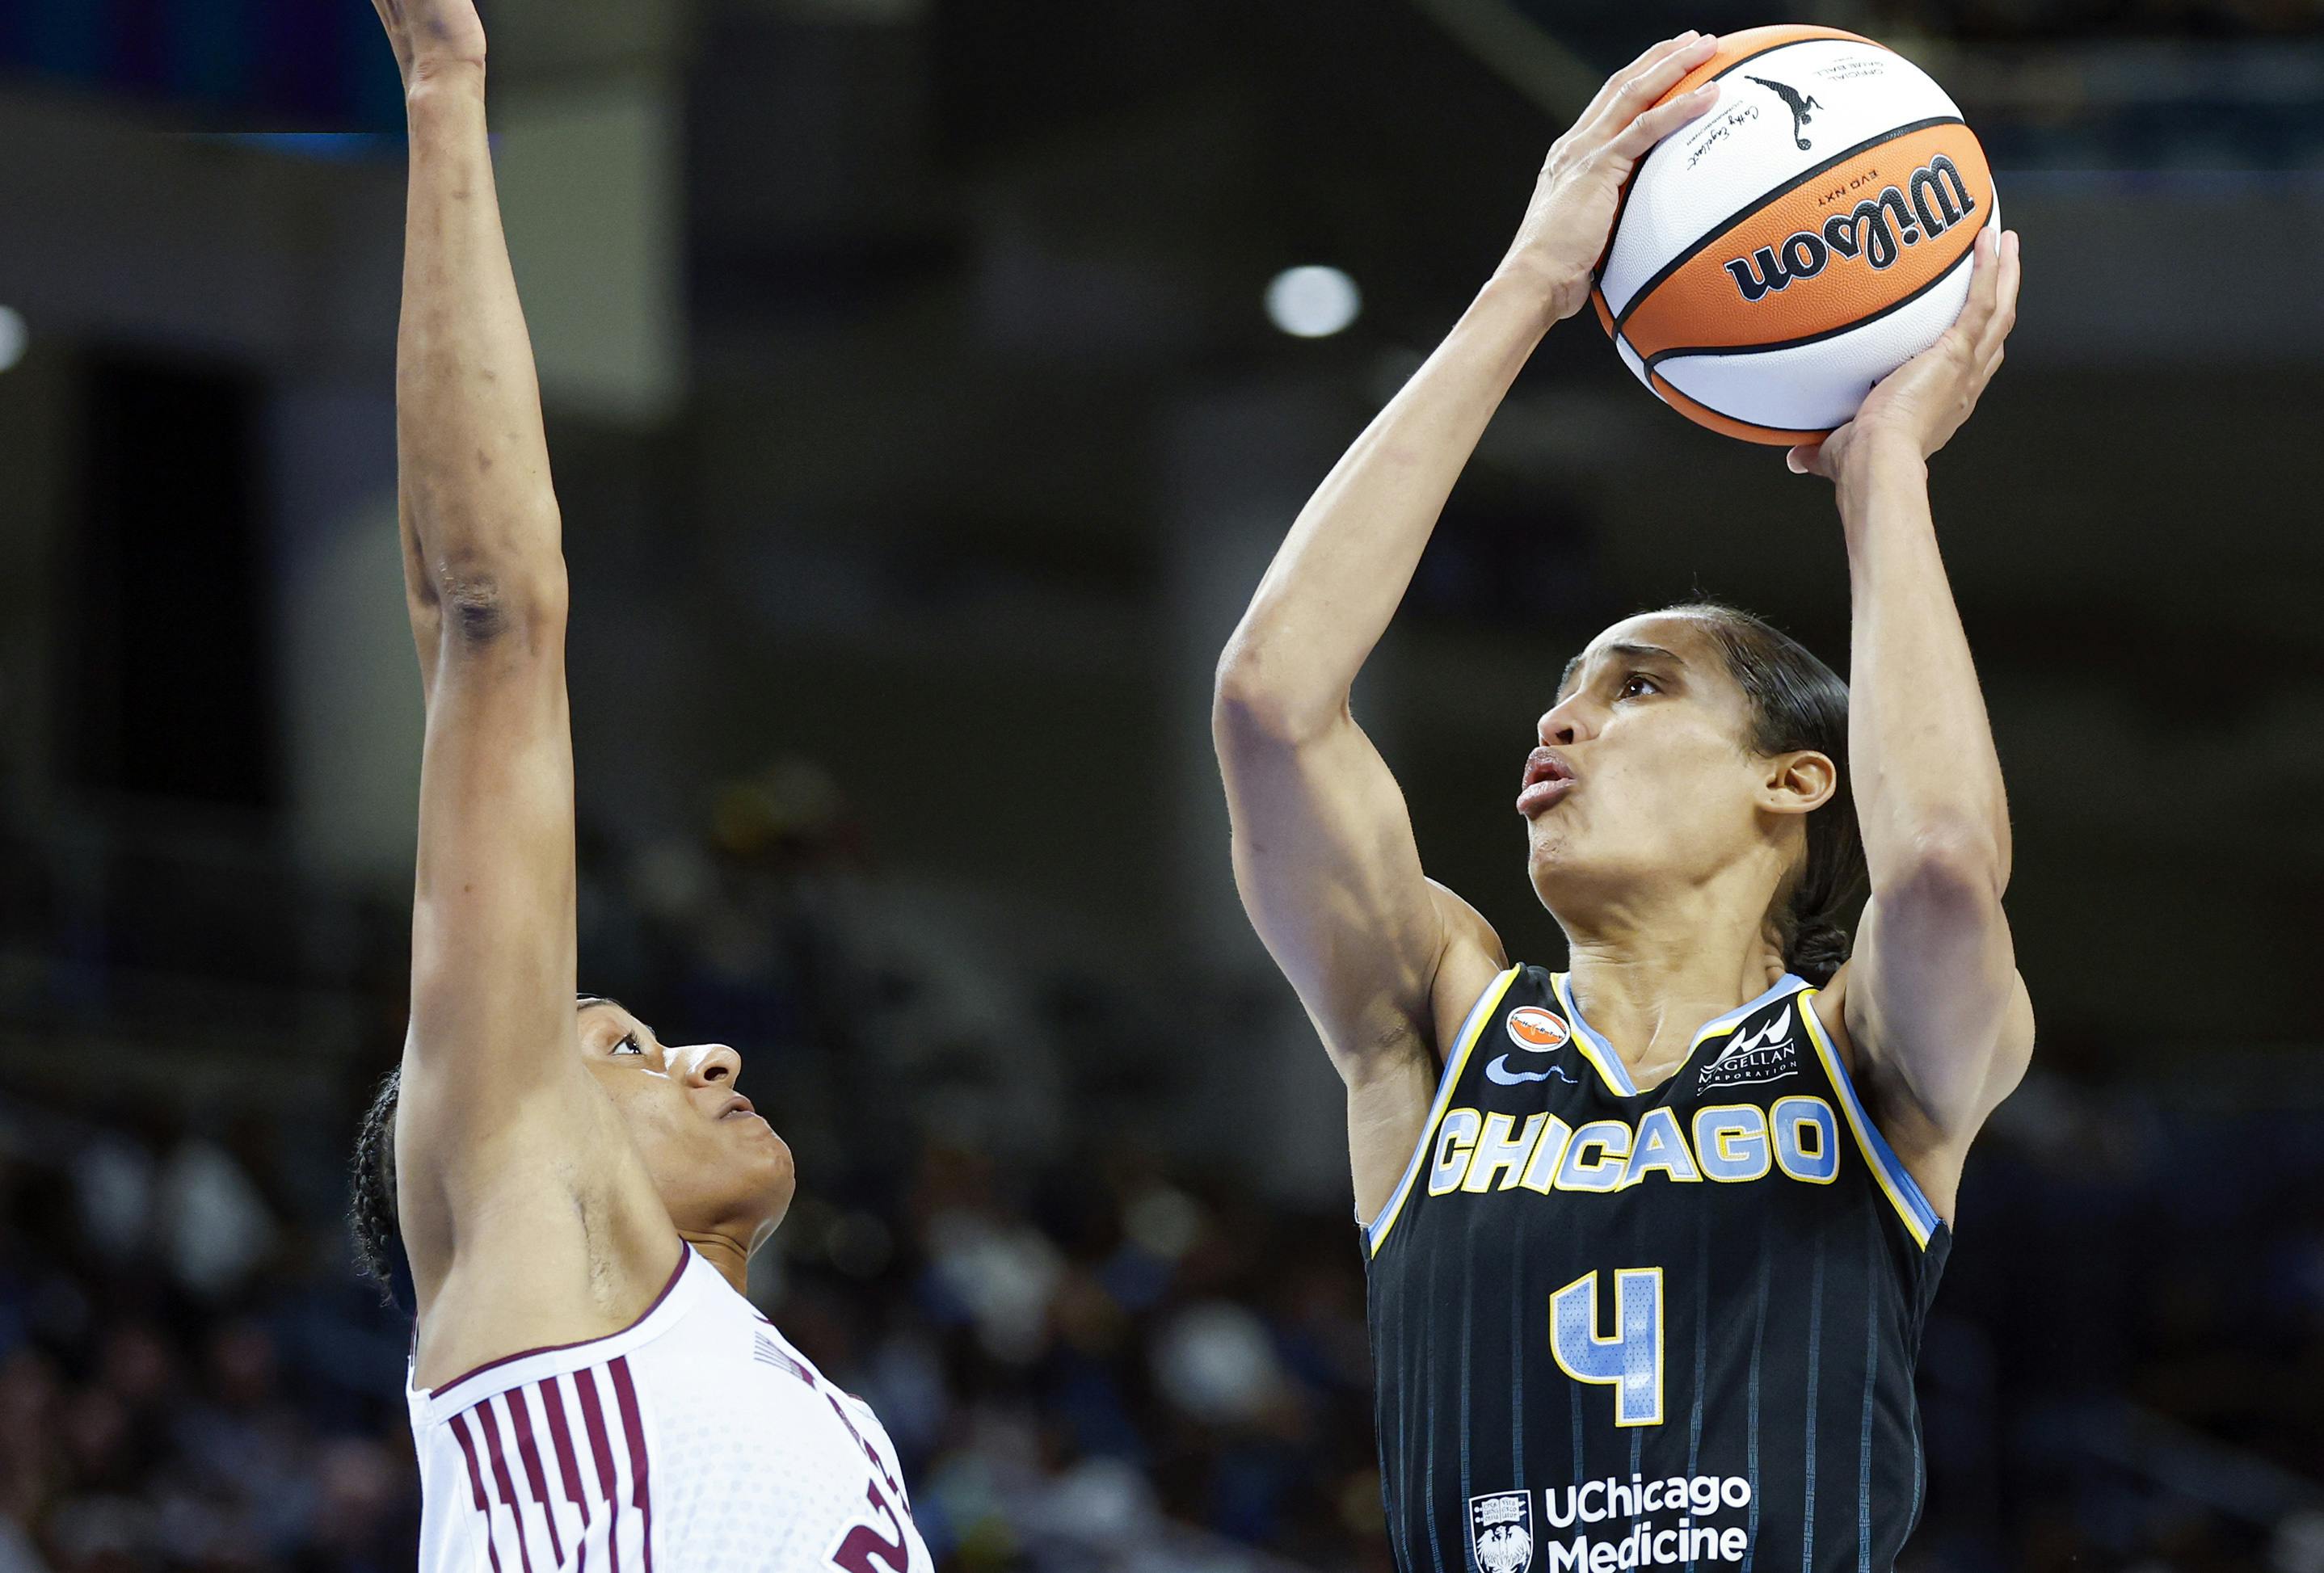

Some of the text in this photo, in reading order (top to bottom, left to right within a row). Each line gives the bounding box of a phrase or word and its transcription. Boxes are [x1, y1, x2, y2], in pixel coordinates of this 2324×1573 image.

[1817, 169, 1878, 208] EVO NXT
[1724, 154, 1977, 302] Wilson
[1697, 1061, 1797, 1092] CRPORATION
[1427, 1095, 1842, 1197] CHICAGO
[1549, 1266, 1664, 1428] 4
[1545, 1473, 1752, 1529] UChicago
[1547, 1517, 1749, 1573] Medicine
